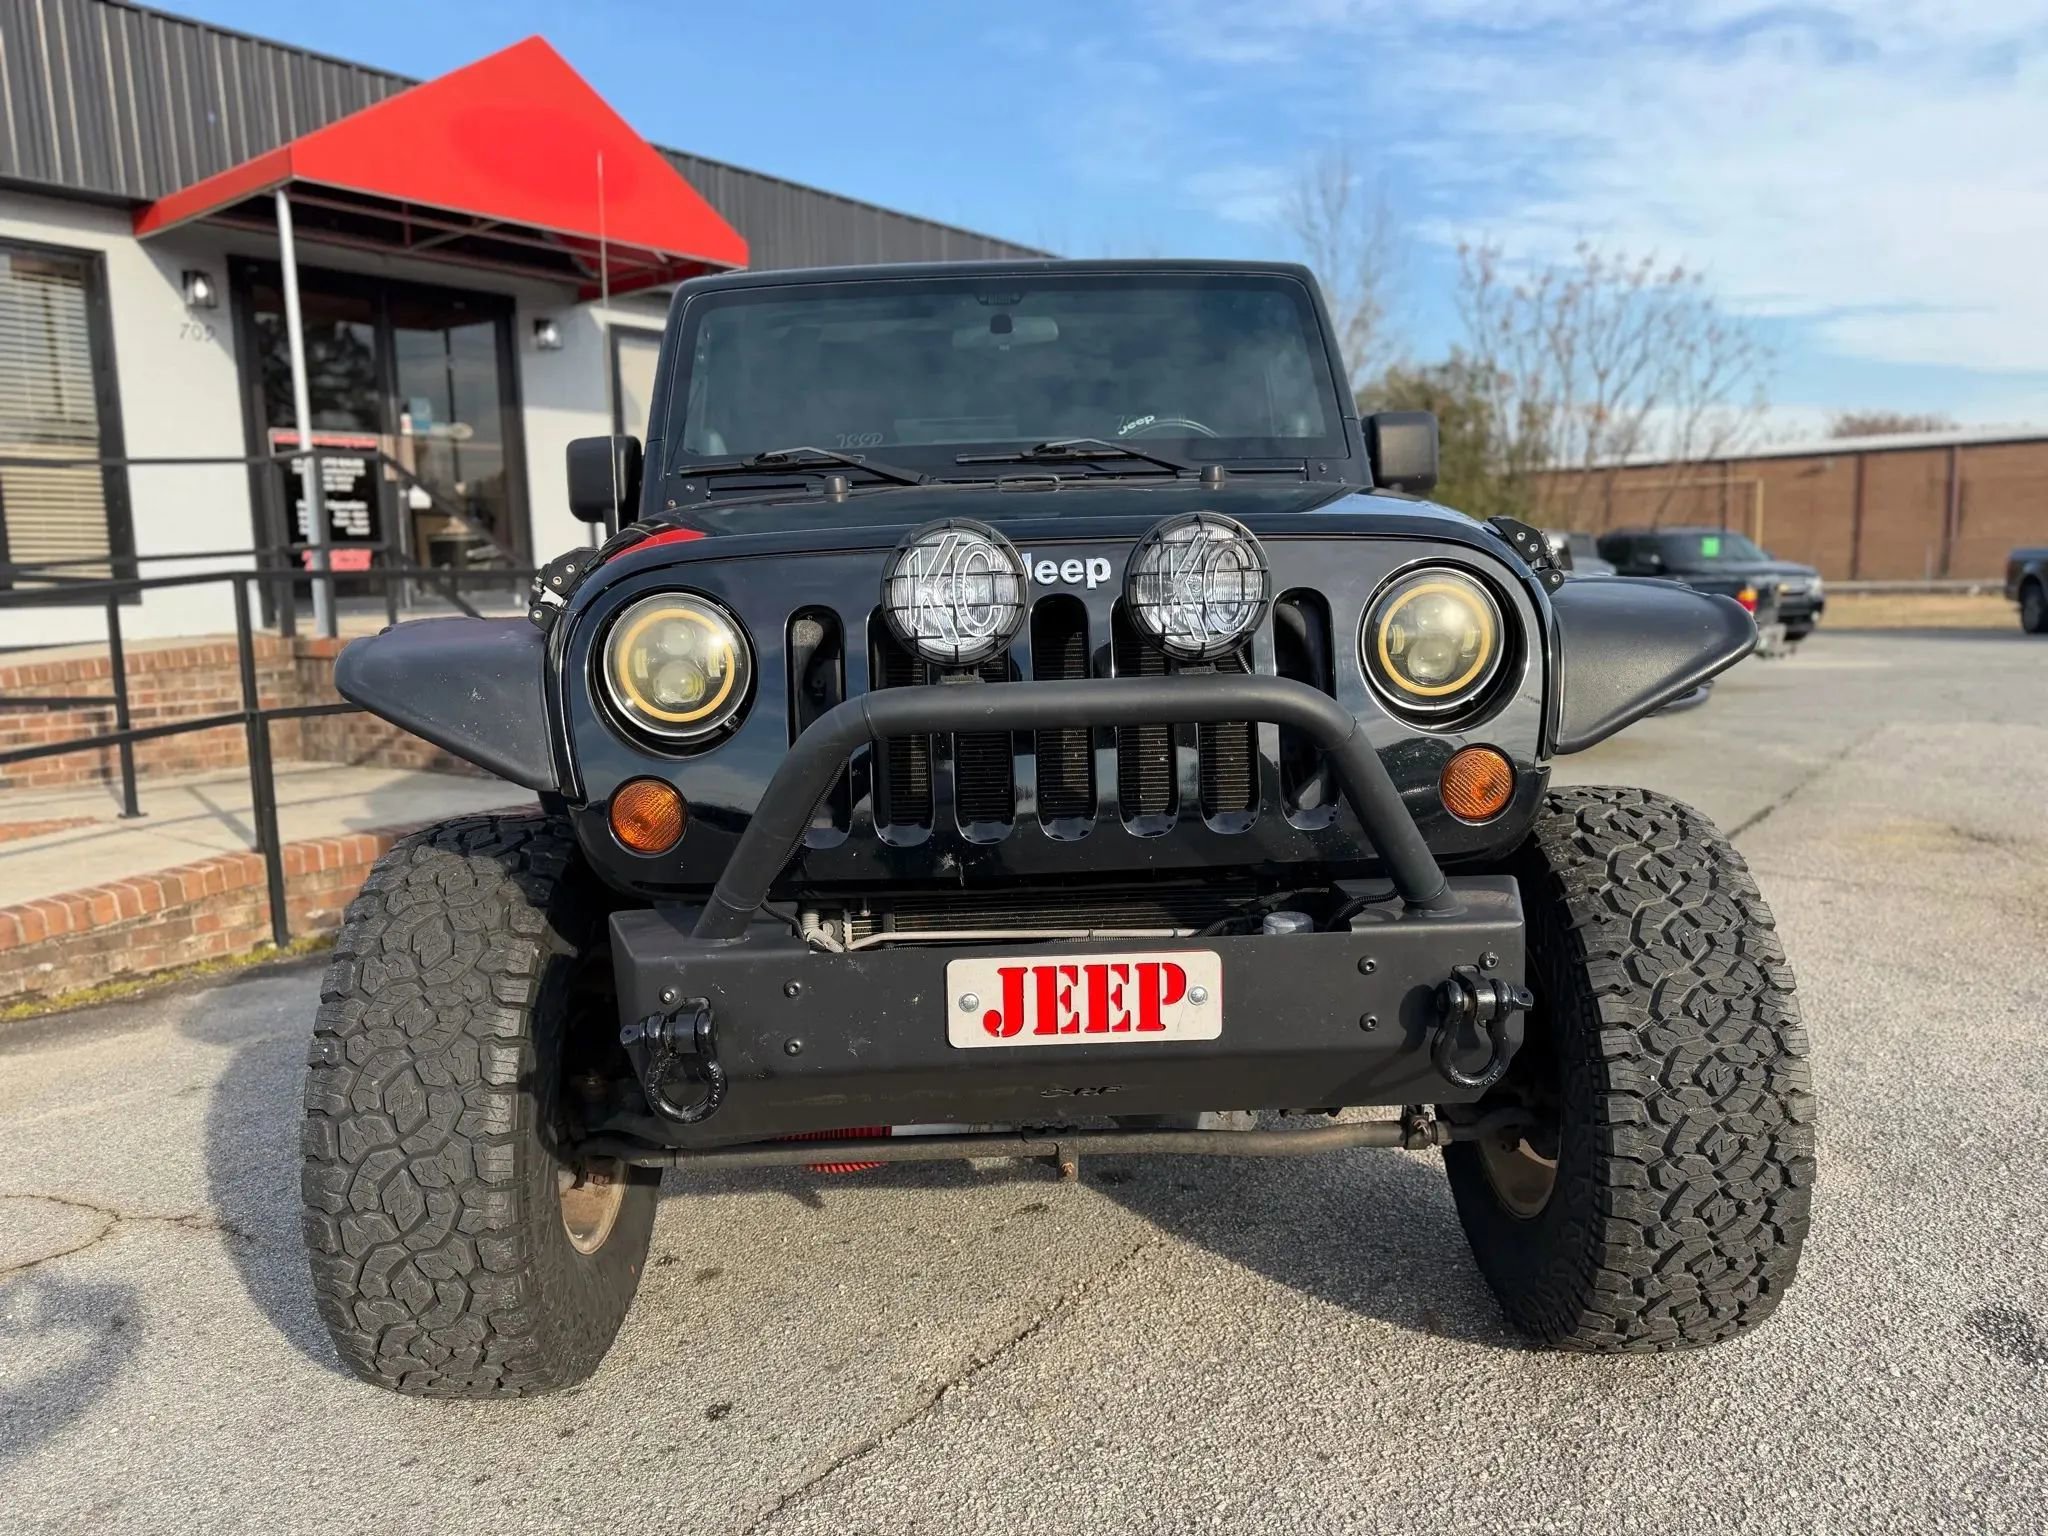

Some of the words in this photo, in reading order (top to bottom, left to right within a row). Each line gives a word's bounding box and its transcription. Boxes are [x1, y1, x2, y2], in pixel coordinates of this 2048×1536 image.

[907, 533, 1004, 645] KC
[1157, 529, 1254, 642] KC
[982, 962, 1187, 1038] JEEP
